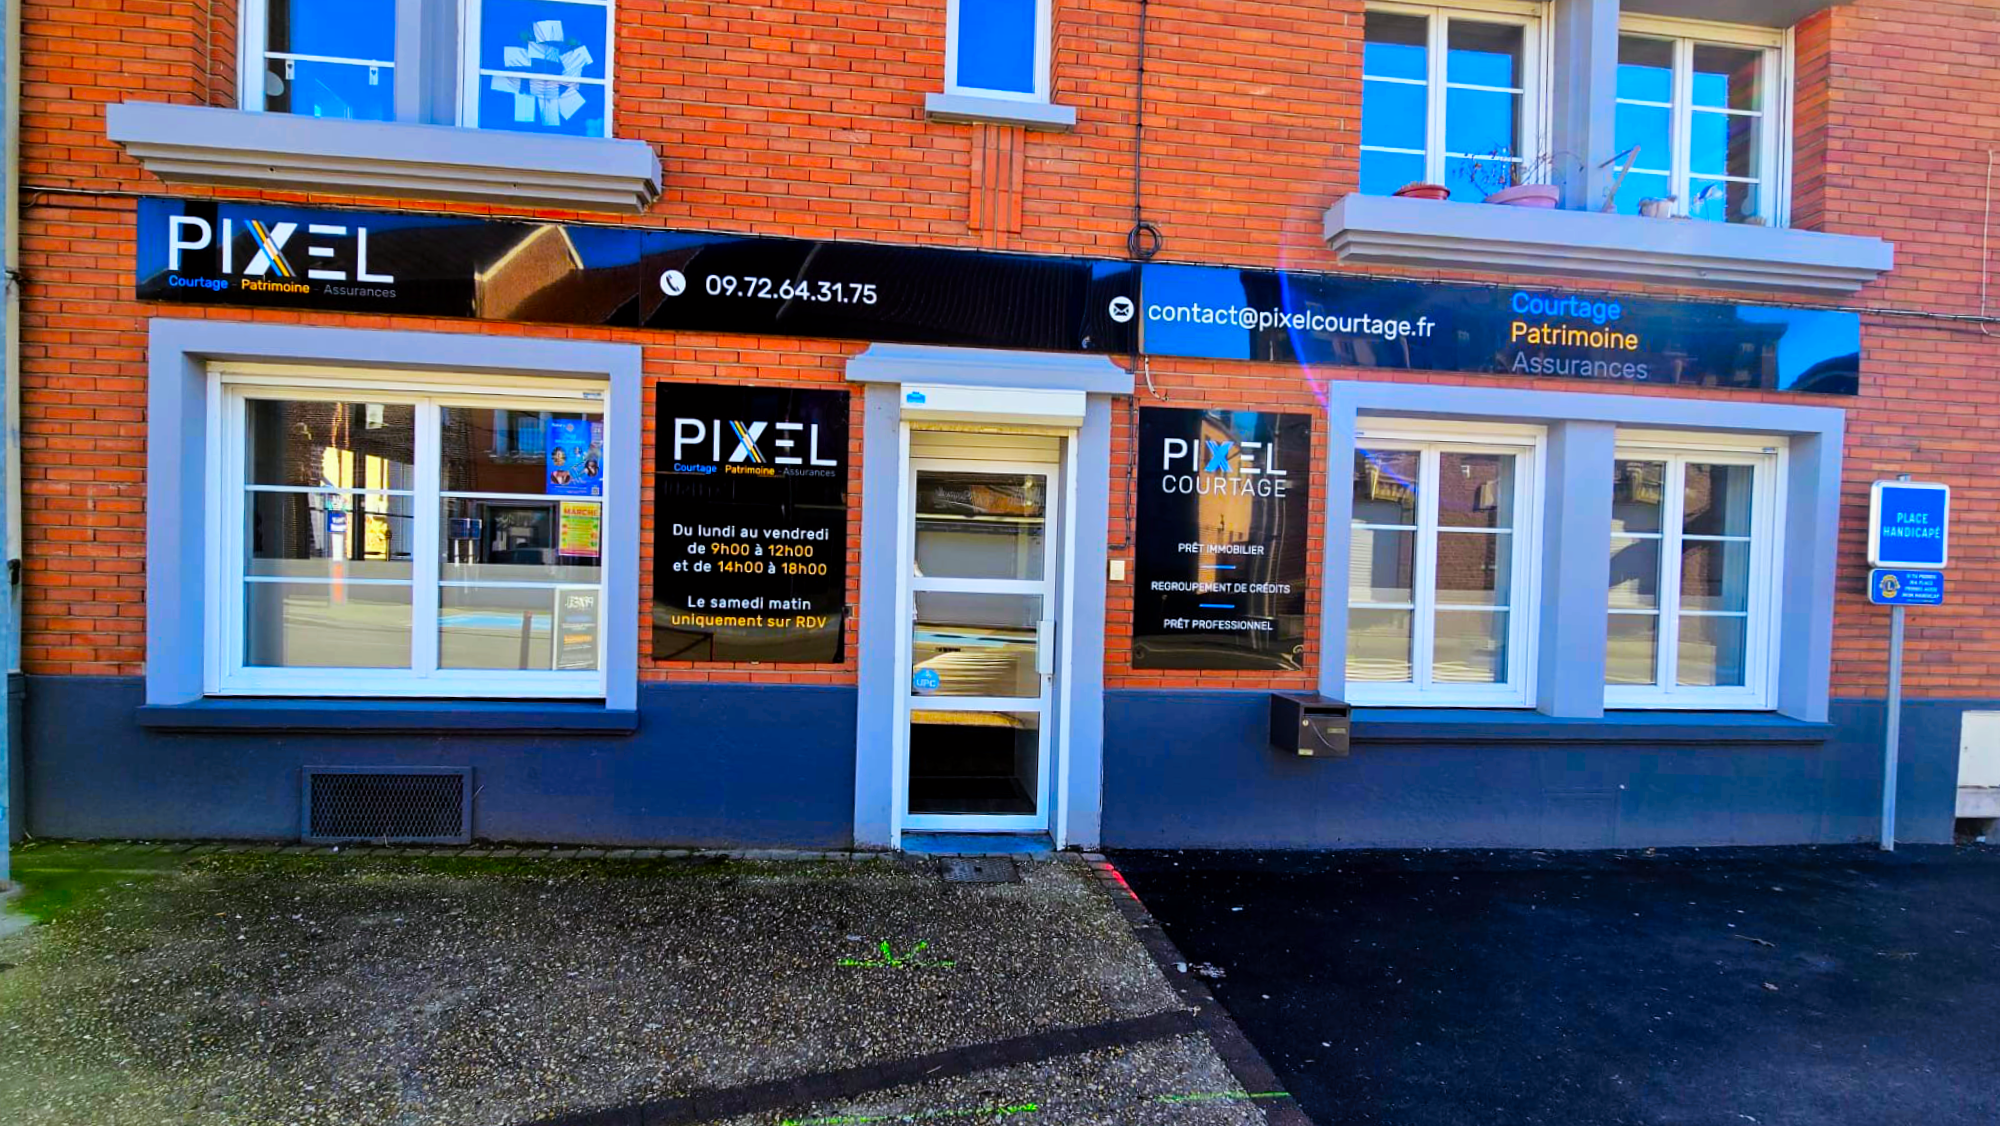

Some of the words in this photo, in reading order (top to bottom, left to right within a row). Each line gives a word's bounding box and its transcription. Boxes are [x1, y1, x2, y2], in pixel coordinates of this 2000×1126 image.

[168, 215, 394, 283] PIXEL
[169, 275, 228, 291] Courtage
[241, 278, 310, 293] Patrimoine
[324, 284, 396, 298] Assurances
[706, 274, 877, 304] 09.72.64.31.75
[1511, 292, 1621, 324] Courtage
[1148, 302, 1435, 340] contact@pixelcourtage.fr
[1511, 321, 1638, 350] Patrimoine
[1511, 351, 1648, 379] Assurances
[674, 417, 837, 466] PIXEL
[1163, 437, 1287, 475] PIXEL
[674, 463, 717, 475] Courtage
[725, 464, 775, 476] Patrimoine
[783, 467, 836, 477] Assurances
[1162, 474, 1286, 498] COURTAGE
[1896, 512, 1929, 524] PLACE
[673, 524, 692, 536] Du
[698, 524, 735, 538] lundi
[740, 527, 758, 539] au
[763, 528, 829, 540] vendredi
[1883, 525, 1941, 539] HANDICAPÉ
[687, 542, 706, 554] de
[711, 542, 750, 556] 9h00
[754, 543, 763, 556] à
[768, 545, 814, 557] 12h00
[1178, 541, 1204, 553] PRÊT
[1206, 544, 1265, 555] IMMOBILIER
[673, 560, 688, 572] et
[693, 560, 711, 572] de
[717, 561, 763, 574] 14h00
[767, 561, 776, 574] à
[781, 562, 827, 576] 18h00
[1151, 581, 1232, 593] REGROUPEMENT
[1234, 582, 1247, 593] DE
[1249, 581, 1291, 594] CRÉDITS
[688, 595, 705, 608] Le
[710, 596, 764, 610] samedi
[769, 598, 811, 610] matin
[671, 613, 763, 628] uniquement
[767, 617, 791, 628] sur
[796, 616, 827, 628] RDV
[1163, 617, 1190, 629] PRÊT
[1192, 619, 1273, 631] PROFESSIONNEL
